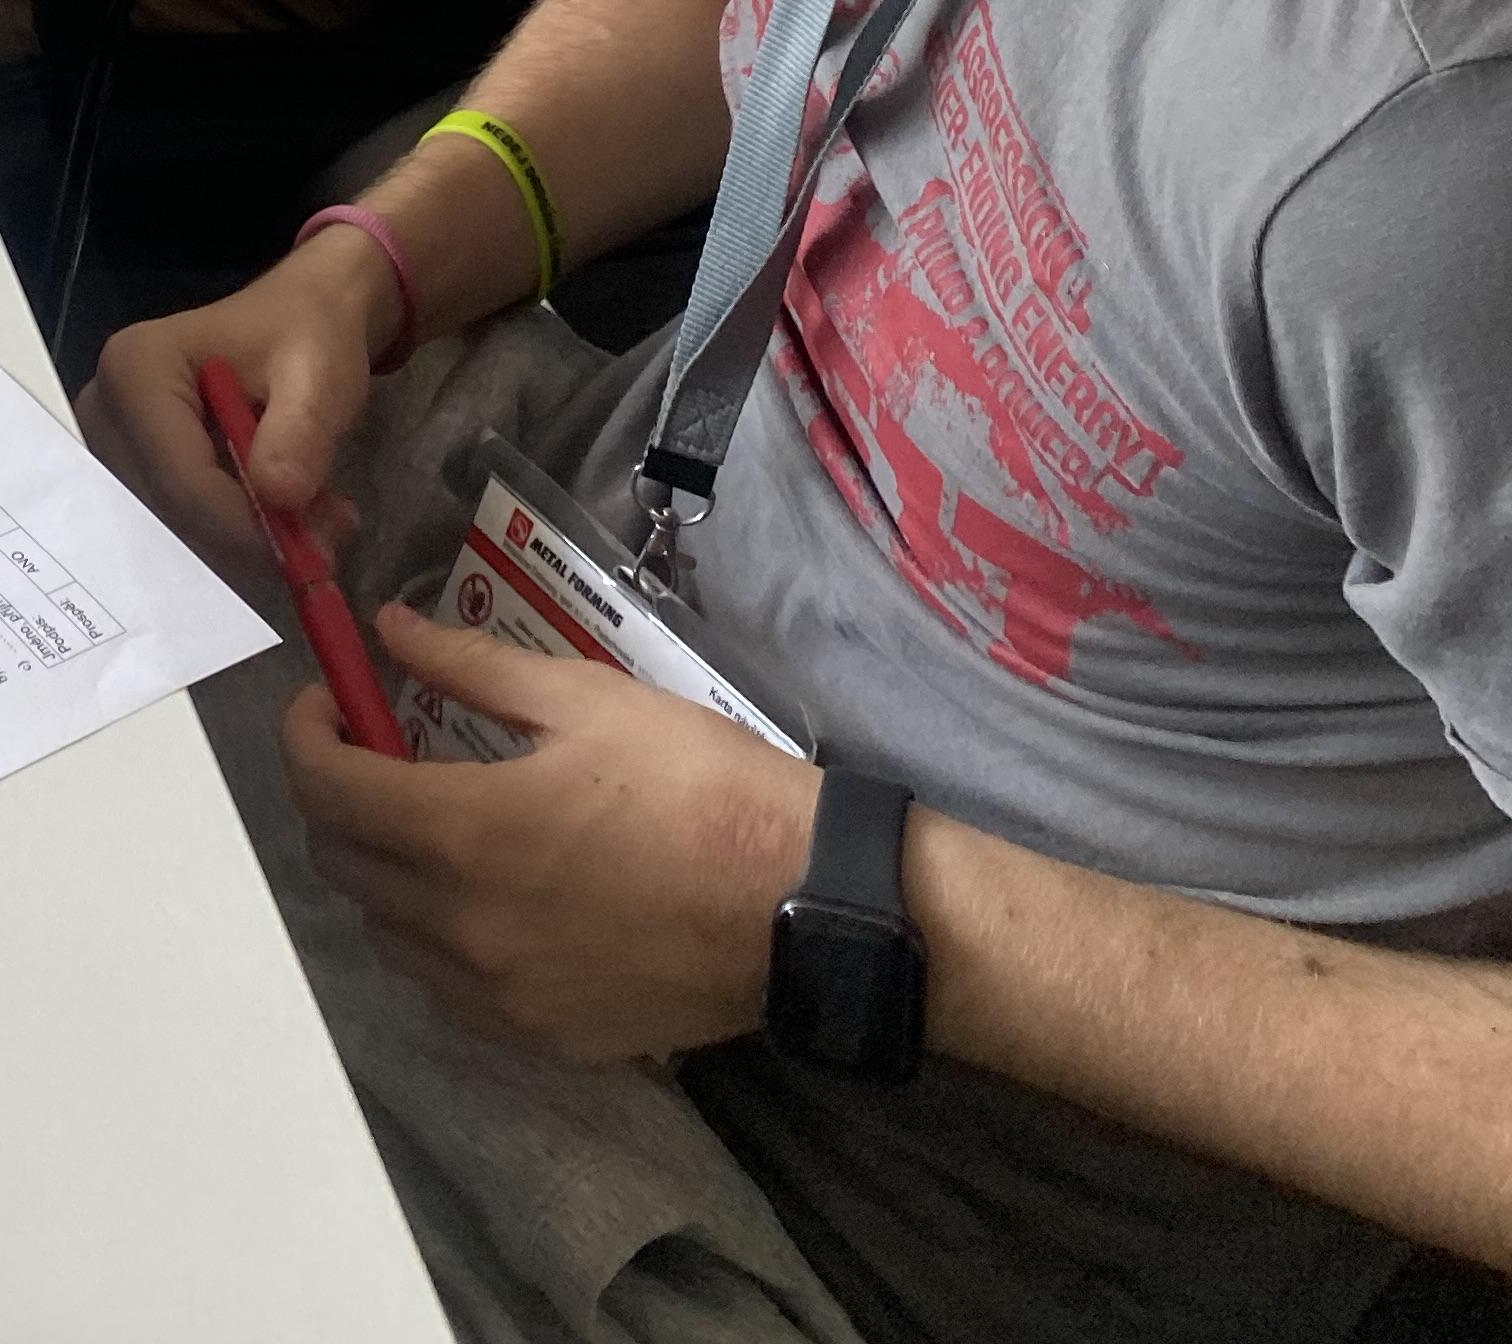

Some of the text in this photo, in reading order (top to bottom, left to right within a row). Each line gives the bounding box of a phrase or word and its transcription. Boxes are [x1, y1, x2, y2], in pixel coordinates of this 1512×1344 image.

[925, 31, 1145, 464] VER-ENDING ENERGY
[10, 550, 40, 573] ANO
[528, 537, 625, 629] METAL FORMING
[708, 686, 733, 718] Karta
